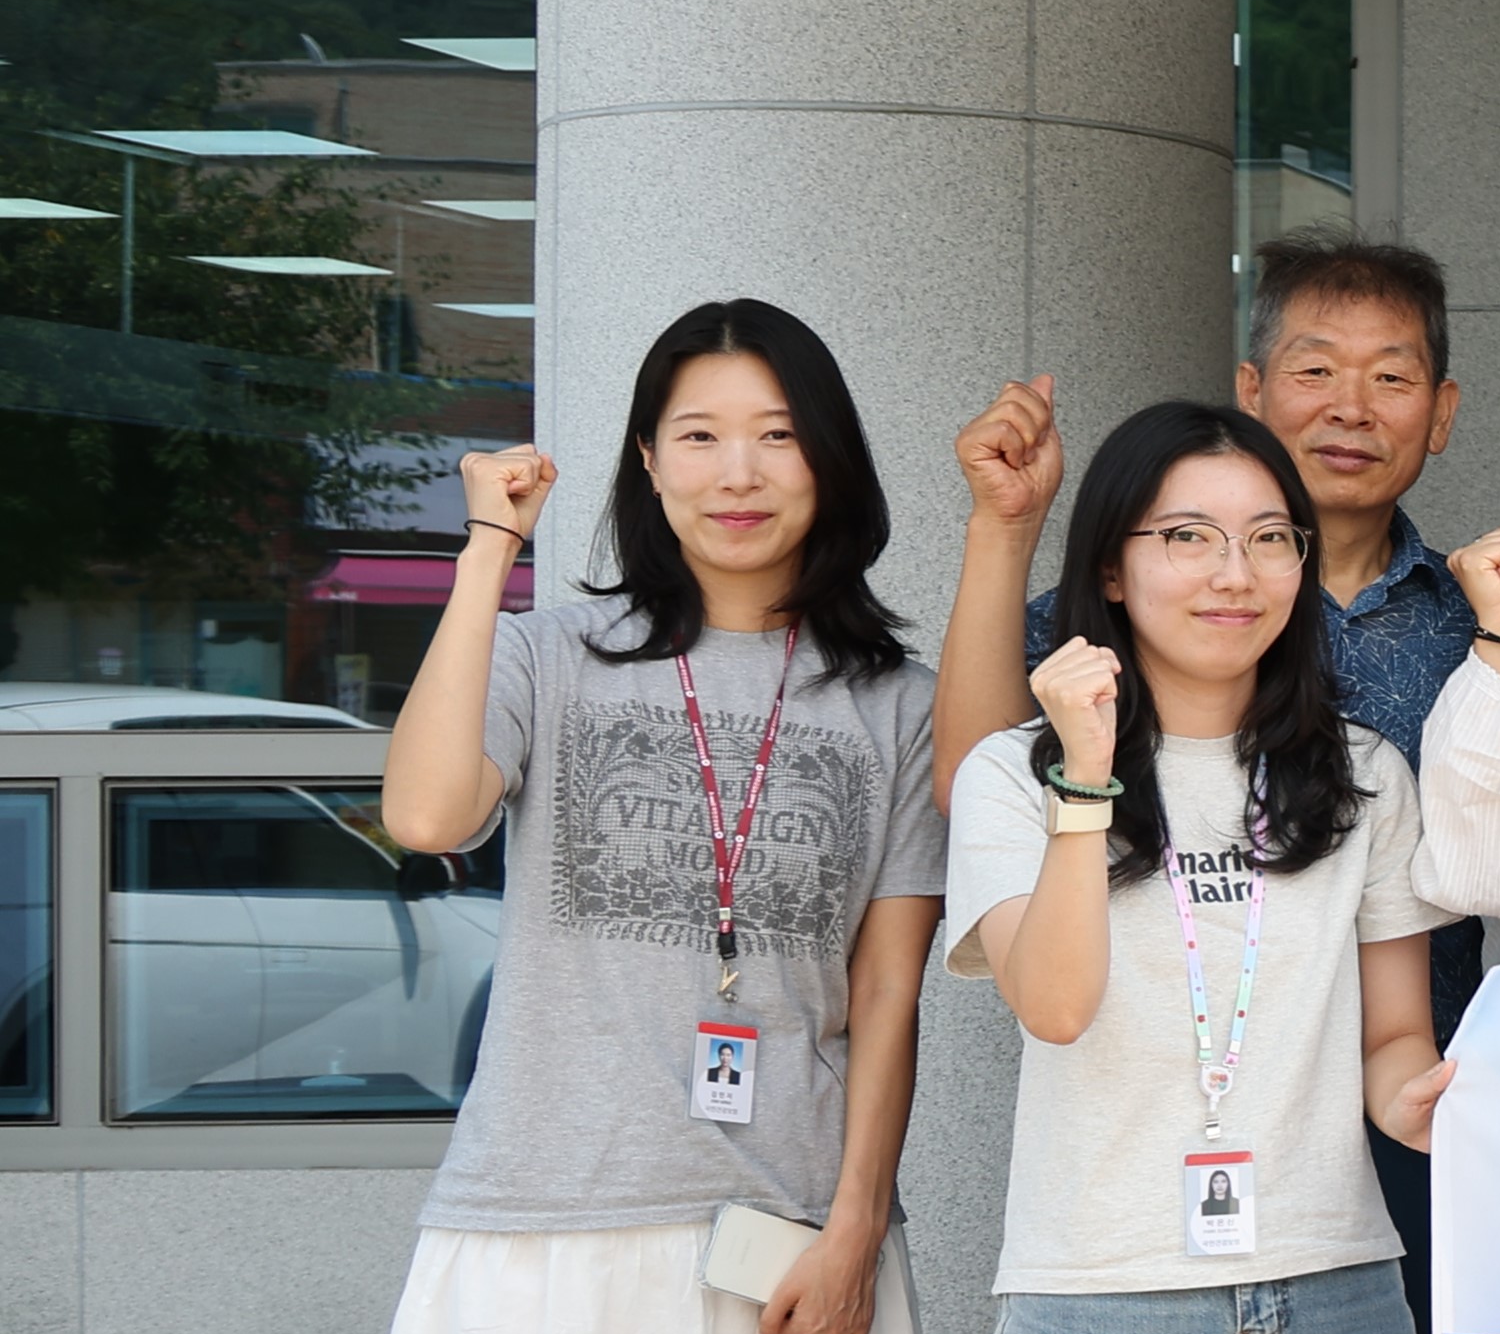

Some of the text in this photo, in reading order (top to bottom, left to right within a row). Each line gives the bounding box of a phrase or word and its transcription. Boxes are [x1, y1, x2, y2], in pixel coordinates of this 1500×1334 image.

[614, 795, 826, 847] VITAIGN
[664, 839, 767, 875] MOD
[1176, 843, 1243, 875] mari
[1184, 876, 1265, 904] lair
